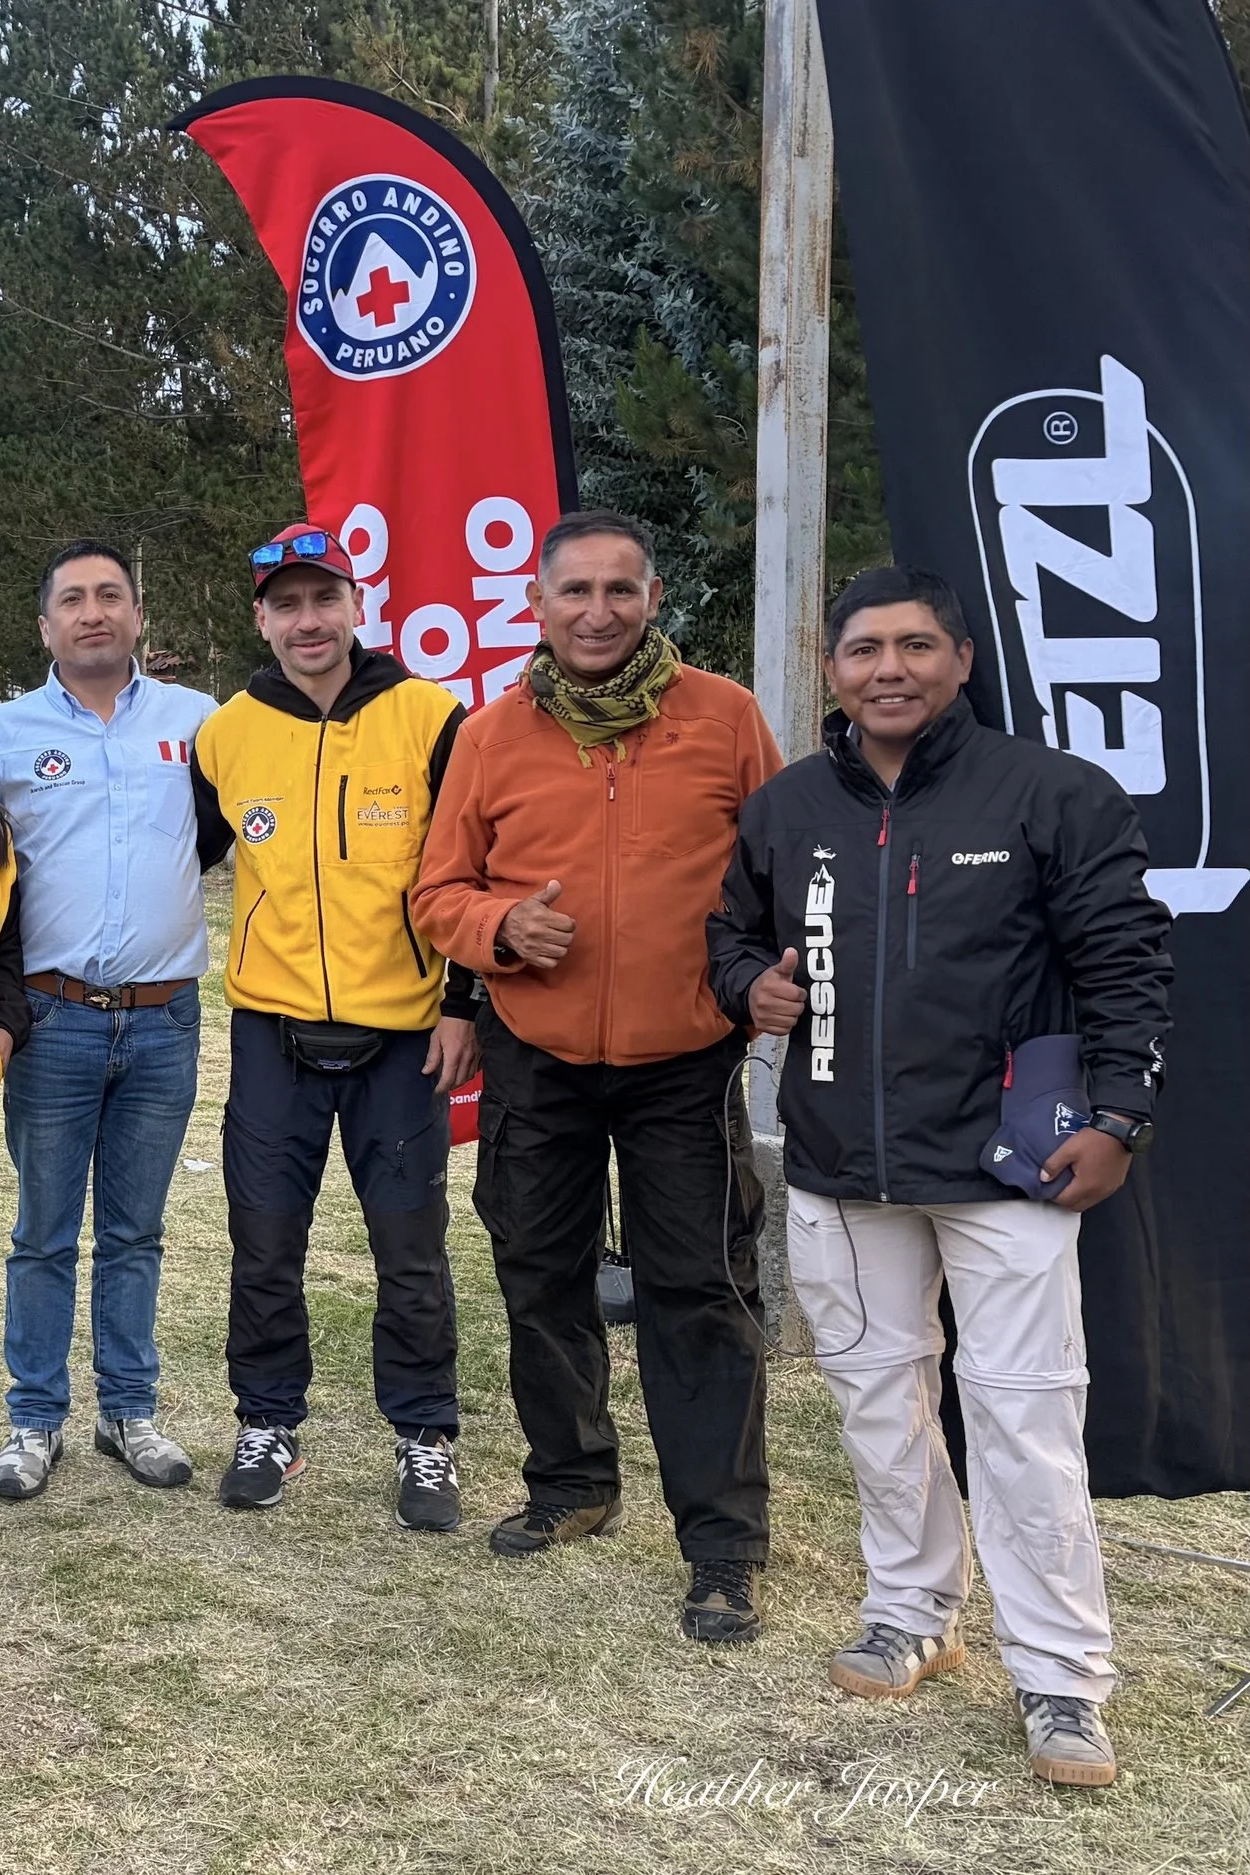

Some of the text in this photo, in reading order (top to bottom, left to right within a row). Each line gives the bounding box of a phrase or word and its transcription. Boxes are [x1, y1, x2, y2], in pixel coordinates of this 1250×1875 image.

[303, 187, 465, 316] SOCORRO ANDINO
[336, 316, 445, 368] PERUANO
[339, 503, 393, 652] RO
[991, 354, 1250, 919] ETZL
[357, 805, 410, 820] EVEREST
[964, 851, 1010, 865] FERNO
[805, 877, 836, 1083] RESCUE
